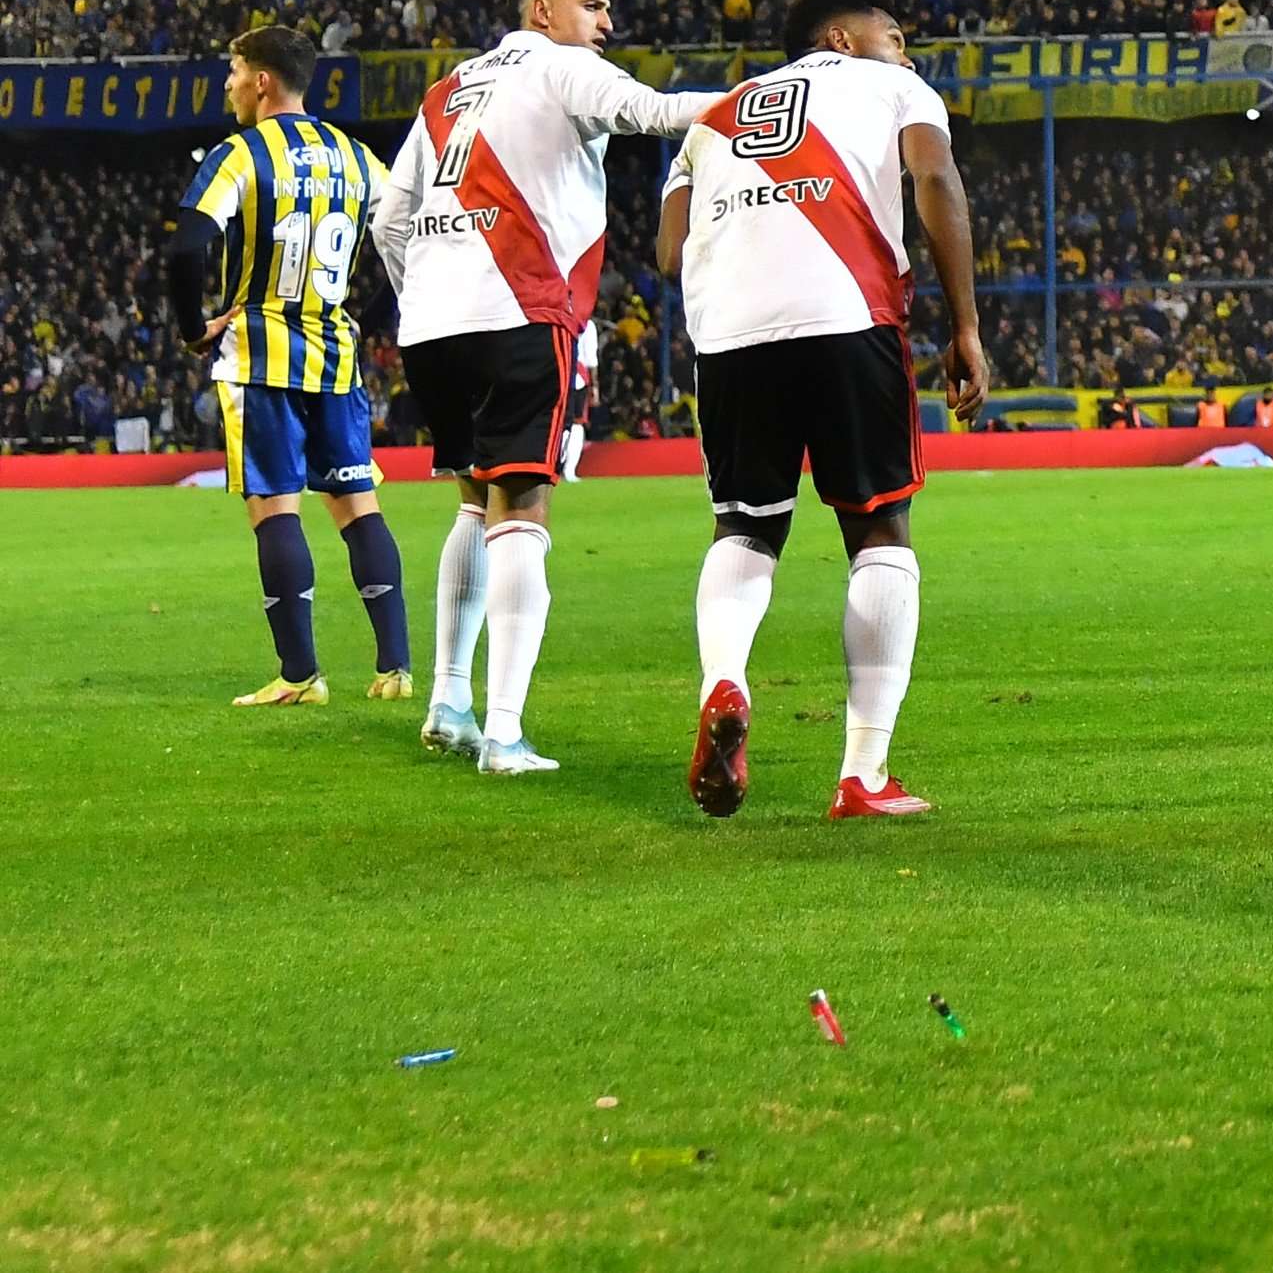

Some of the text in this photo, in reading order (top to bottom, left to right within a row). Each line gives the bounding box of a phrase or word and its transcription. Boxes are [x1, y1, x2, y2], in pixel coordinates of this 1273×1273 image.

[432, 78, 498, 188] 7
[732, 77, 811, 160] 9
[273, 177, 366, 202] INFANTINO
[711, 177, 834, 222] DIRECTV
[272, 211, 358, 305] 19
